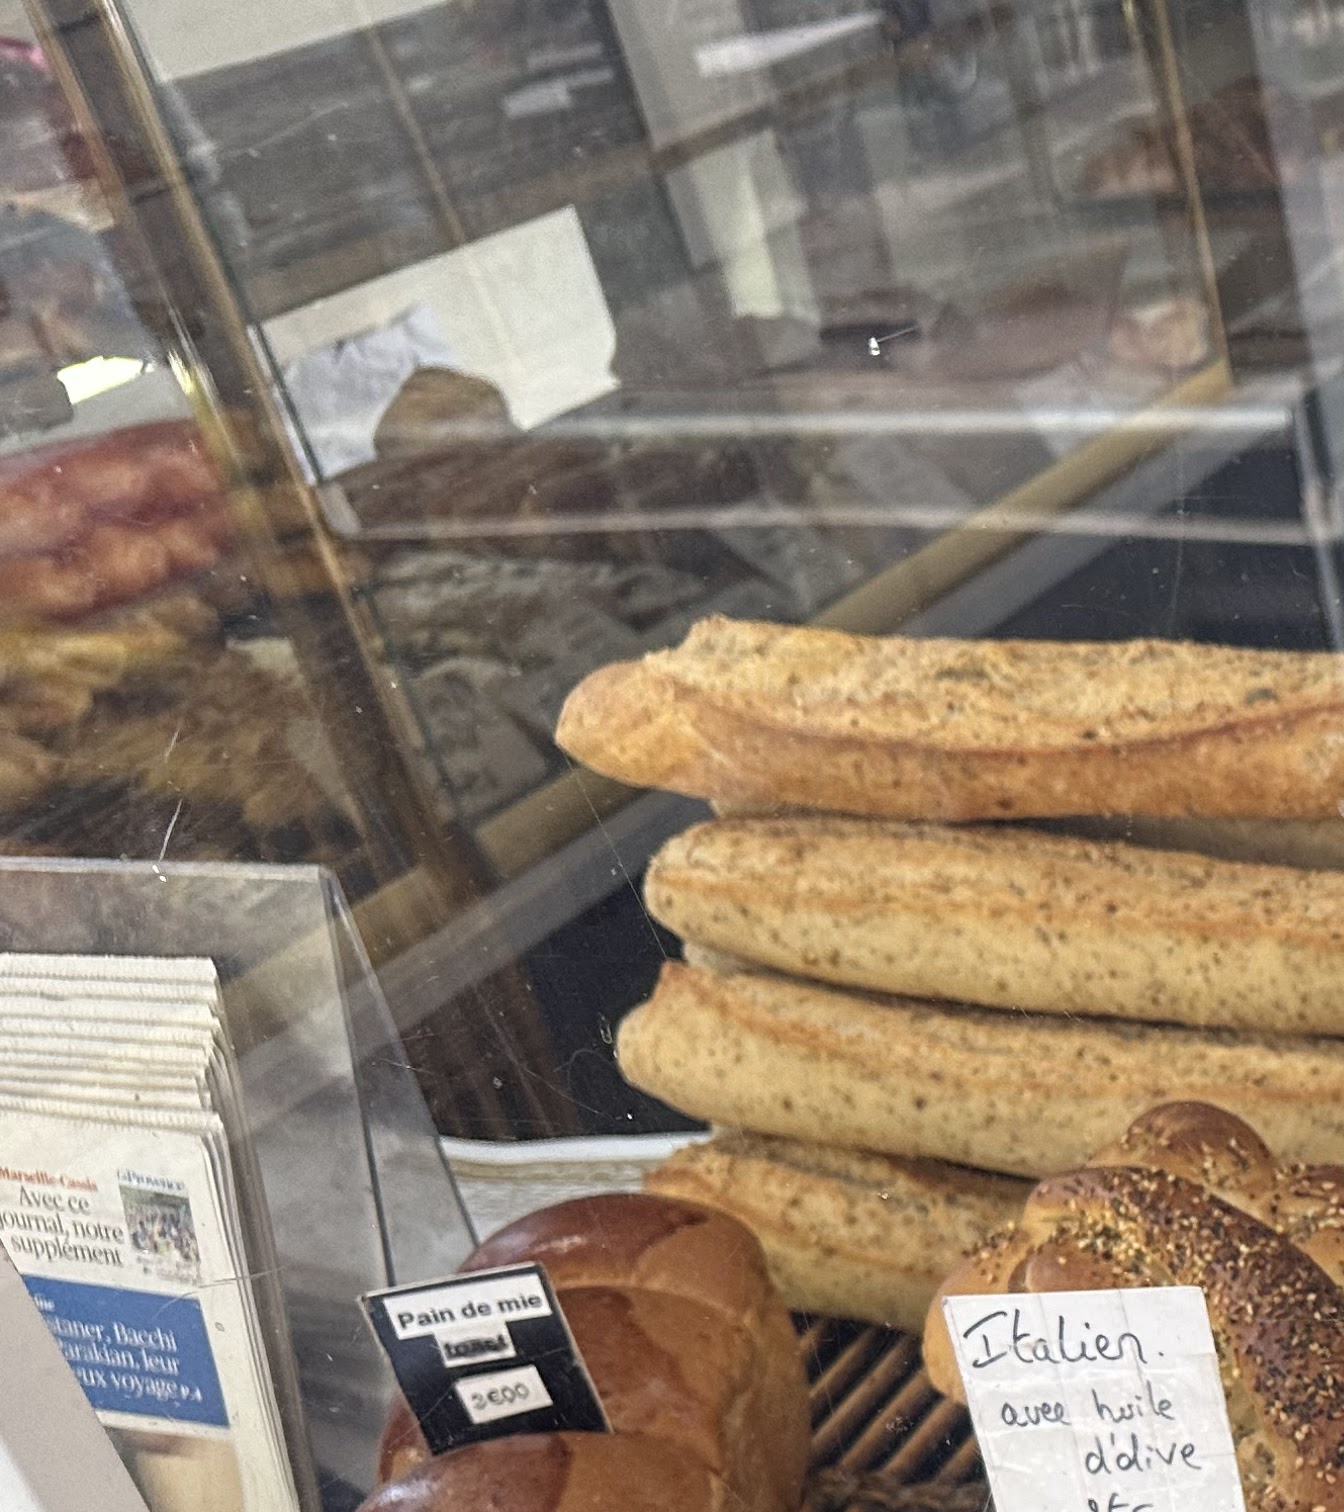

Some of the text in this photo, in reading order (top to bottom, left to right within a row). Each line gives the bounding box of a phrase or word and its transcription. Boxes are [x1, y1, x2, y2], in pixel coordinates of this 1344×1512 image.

[20, 1184, 92, 1216] Avec ce
[72, 1220, 125, 1244] notre
[11, 1236, 124, 1268] supplément
[397, 1292, 543, 1330] Pain de mie
[113, 1321, 178, 1352] Bacchi
[141, 1347, 180, 1376] leur
[110, 1371, 178, 1401] voyage
[1001, 1380, 1176, 1427] avec huile
[1085, 1432, 1202, 1475] d'olive
